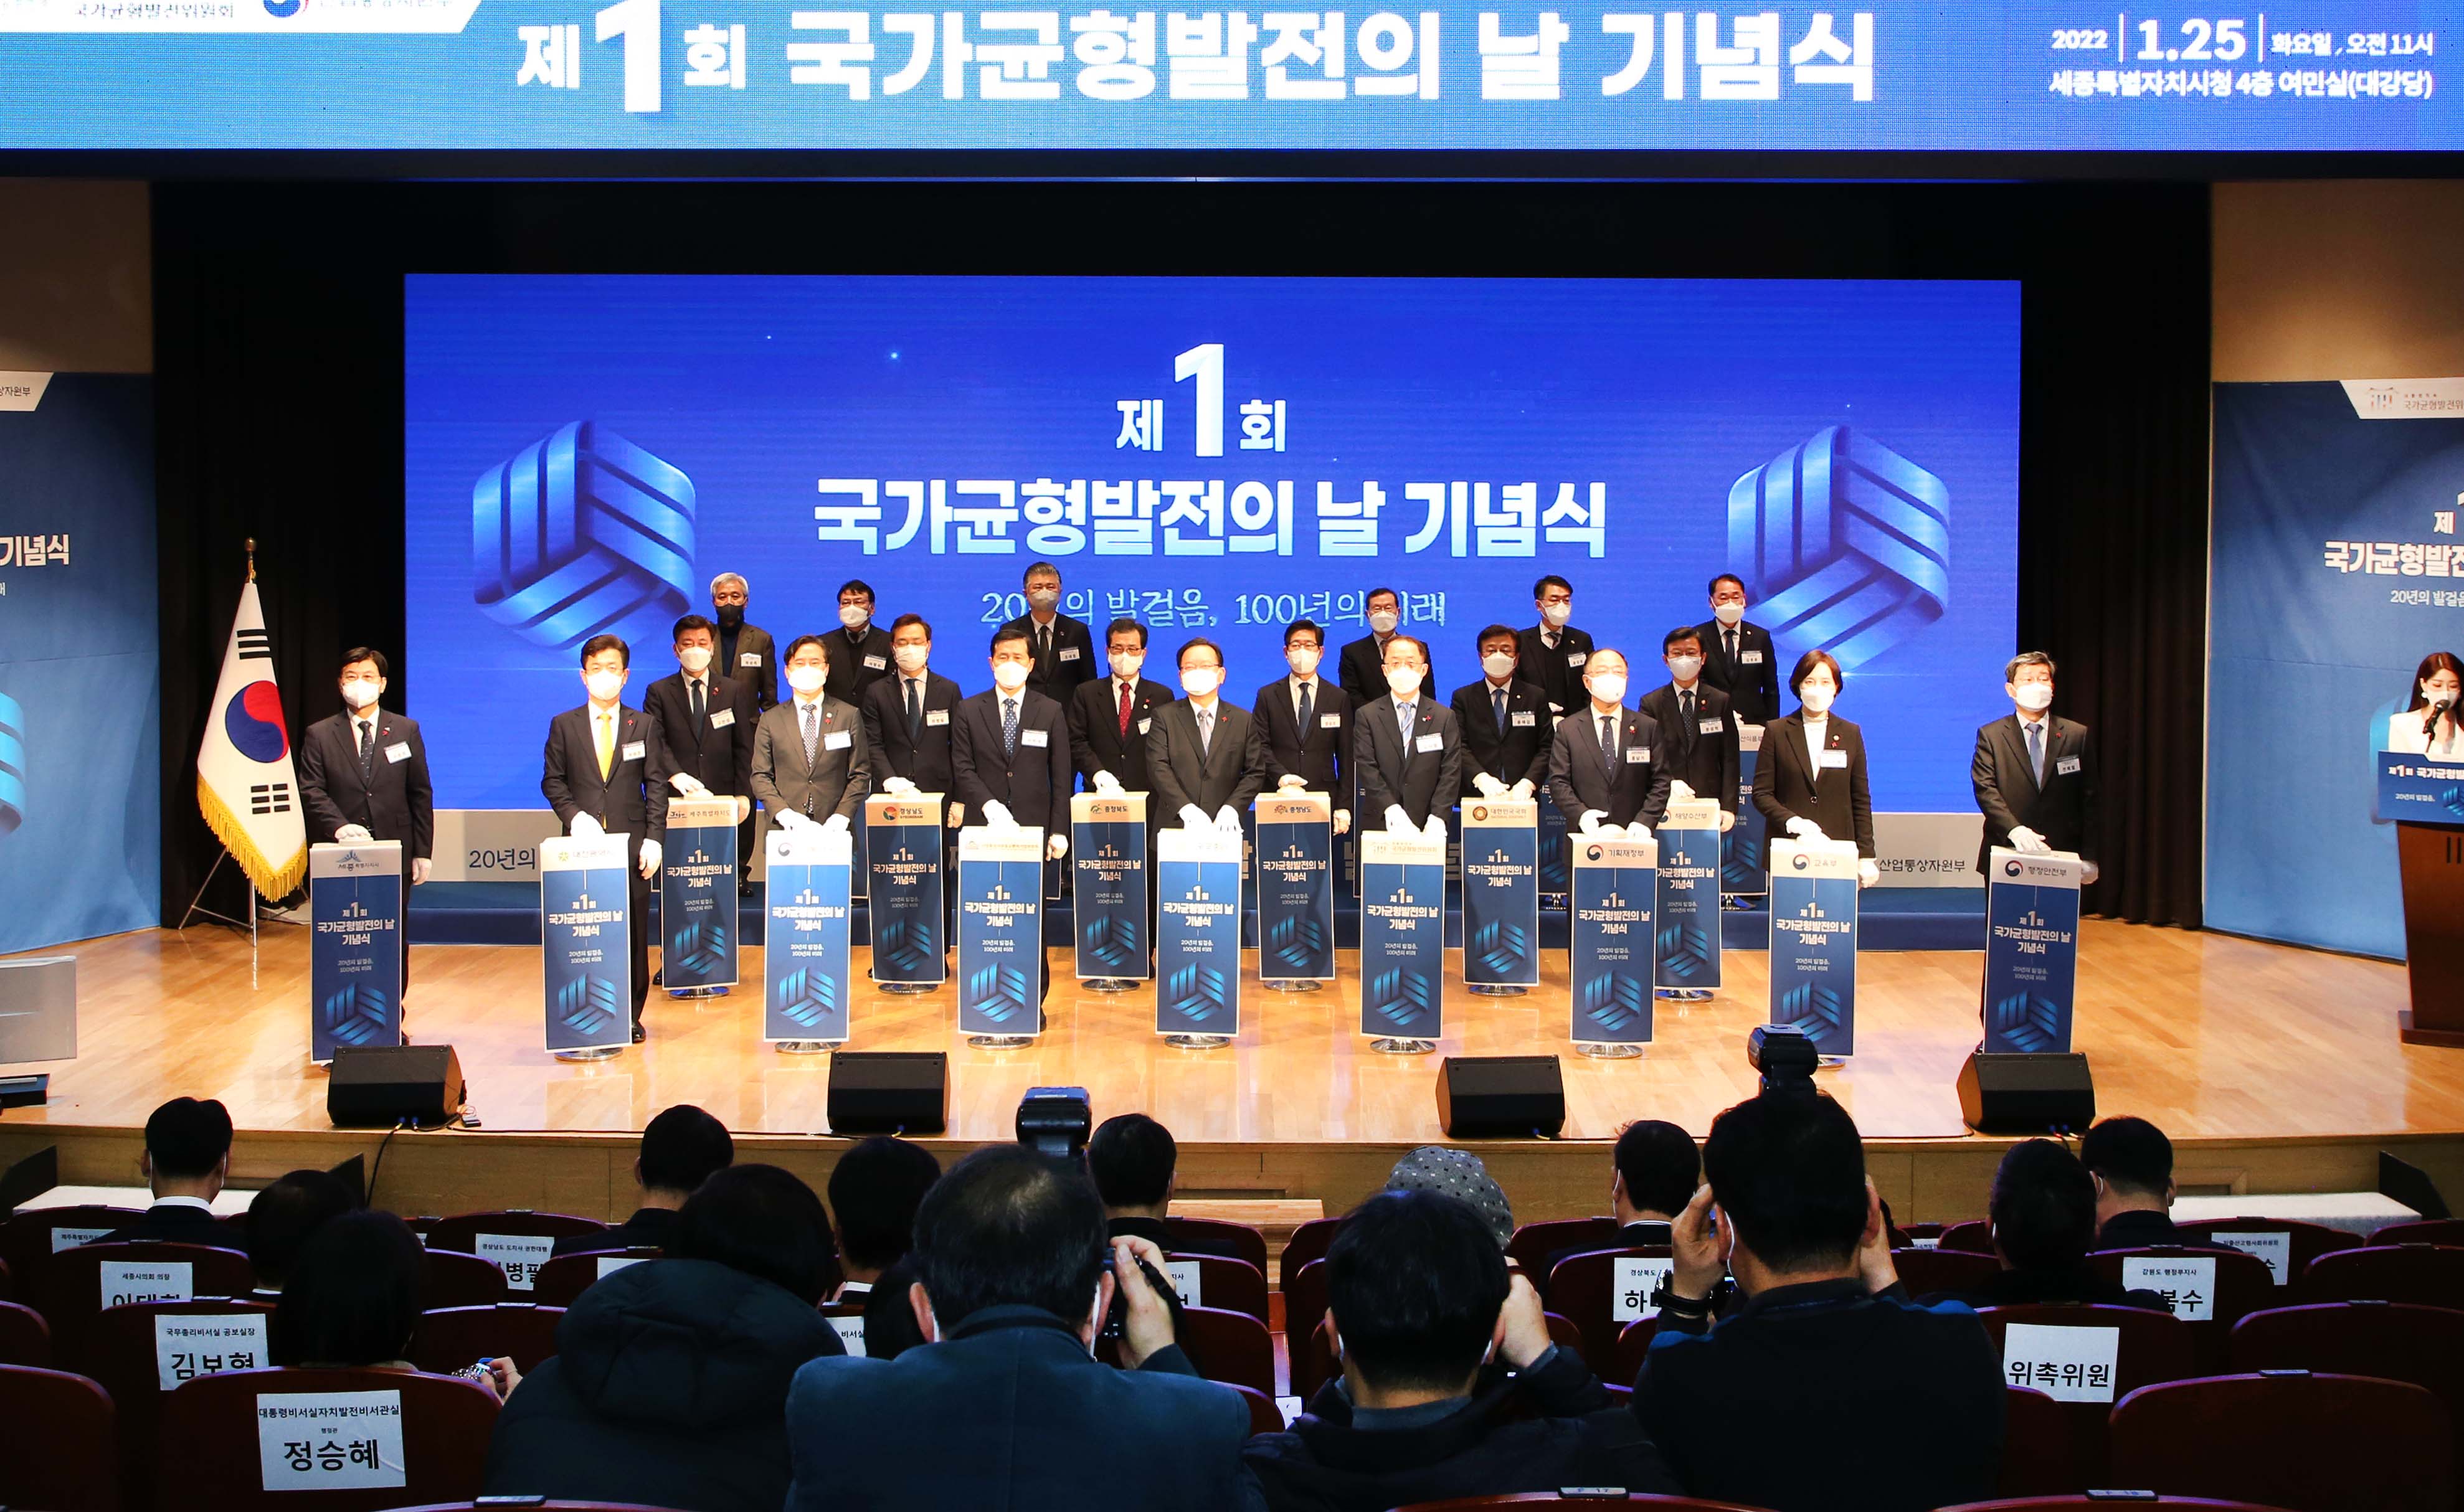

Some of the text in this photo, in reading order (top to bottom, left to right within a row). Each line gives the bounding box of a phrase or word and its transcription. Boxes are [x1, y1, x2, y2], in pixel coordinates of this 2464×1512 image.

[2051, 30, 2109, 49] 2022
[2136, 18, 2246, 61] 1.25
[2346, 32, 2388, 57] 오전
[2391, 32, 2434, 57] 11시
[786, 11, 1439, 102] 국가균형발전의
[1478, 11, 1569, 100] 날
[1601, 11, 1874, 102] 기념식
[2049, 69, 2433, 100] 세종특별자치시청 4층 여민실(대강당)
[2404, 399, 2464, 412] 국가균형발전위
[814, 478, 1607, 559] 국가균형발전의 날 기념식
[0, 534, 70, 567] 기념식
[2390, 590, 2430, 606] 20년의
[980, 588, 1094, 627] 20의
[1106, 588, 1219, 628] 발걸음,
[1235, 590, 1366, 628] 100년의
[1608, 849, 1644, 857] 기획재정부
[468, 848, 536, 871] 20년의
[1078, 859, 1141, 869] 국가균형발전의 날
[1814, 859, 1837, 867] 교육부
[1879, 859, 1965, 872] 산업통상자원부
[667, 864, 732, 876] 국가균형발전의 날
[873, 863, 936, 874] 국가균형발전의 날
[1263, 861, 1326, 871] 국가균형발전의 날
[1468, 865, 1532, 875] 국가균형발전의 날
[2028, 866, 2067, 876] 행정안전부
[1099, 871, 1121, 881] 기념식
[1283, 872, 1306, 882] 기념식
[1657, 867, 1715, 878] 가균형발전의 날
[688, 877, 711, 888] 기념식
[893, 875, 916, 884] 기념식
[1488, 877, 1512, 887] 기념식
[1670, 879, 1694, 889] 기념식
[965, 902, 1036, 914] 국가균형발전의 날
[1163, 902, 1234, 915] 국가균형발전의 날
[1367, 905, 1438, 918] 국가균형발전의 날
[549, 910, 623, 925] 국가균형발전의 날
[987, 915, 1013, 927] 기념식
[1186, 915, 1211, 927] 기념식
[1579, 910, 1651, 922] 국가균형발전의 날
[318, 919, 395, 933] 국가균형발전의 날
[1389, 919, 1415, 930] 기념식
[1602, 923, 1627, 934] 기념식
[1776, 919, 1850, 933] 국가균형발전의 날
[572, 925, 599, 937] 기념식
[1994, 925, 2072, 943] 국가균형발전의 날
[342, 933, 370, 945] 기념식
[1799, 933, 1826, 945] 기념식
[2017, 942, 2046, 954] 기념식
[166, 1328, 256, 1337] 국무총리비서실 공보실장
[2009, 1361, 2110, 1388] 위촉위원
[258, 1404, 400, 1419] 대통령비서실자치발전비서관실
[283, 1439, 380, 1472] 정승혜
